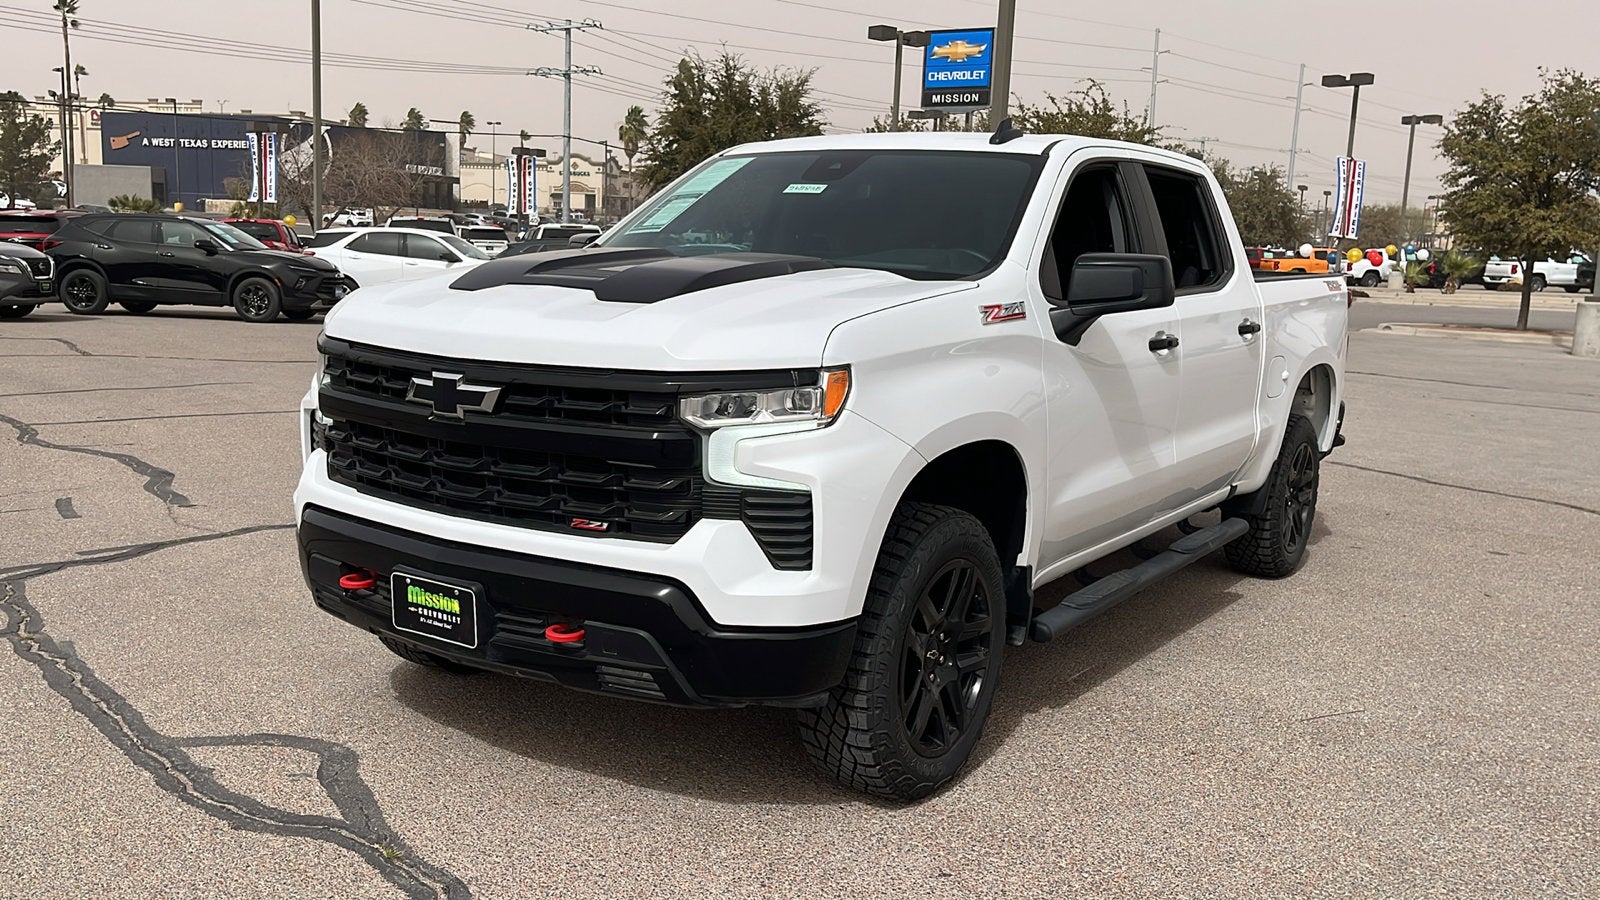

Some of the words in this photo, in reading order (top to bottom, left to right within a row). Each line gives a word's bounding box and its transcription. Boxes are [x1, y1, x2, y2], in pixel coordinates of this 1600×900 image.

[928, 70, 986, 81] CHEVROLET
[931, 93, 979, 104] MISSION
[142, 137, 150, 147] A
[151, 137, 176, 148] WEST
[179, 138, 208, 148] TEXAS
[570, 517, 609, 531] Z71
[418, 607, 461, 624] CHEVROLET
